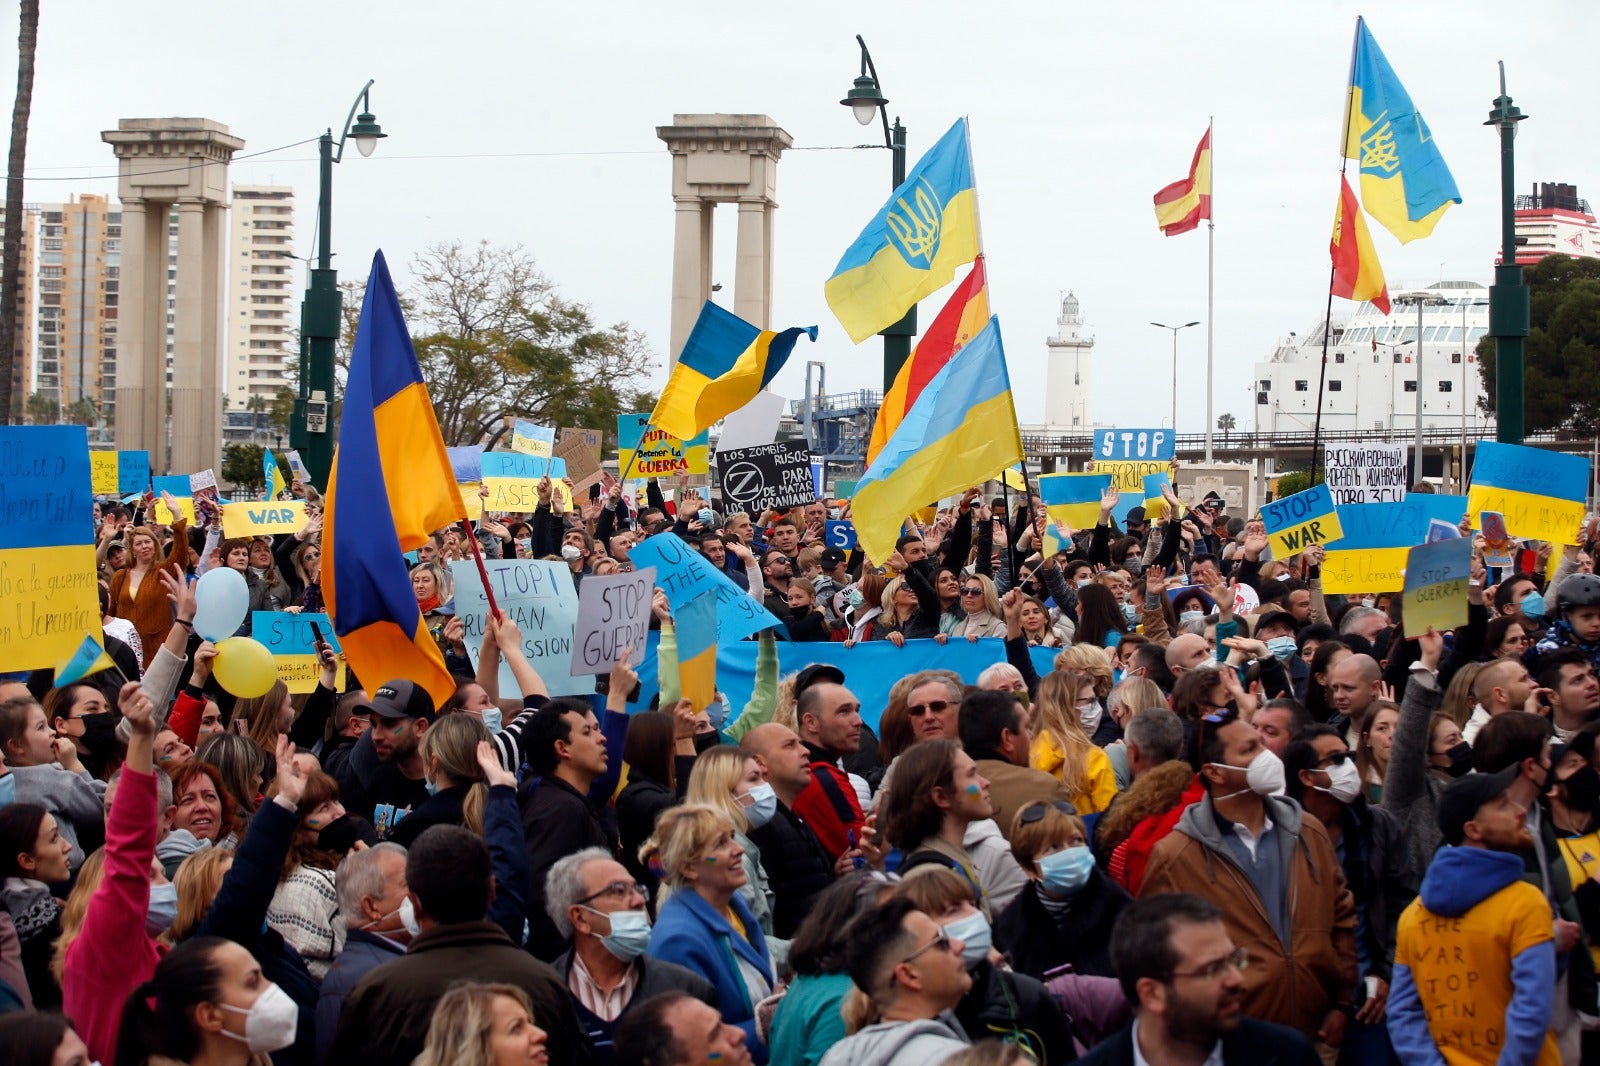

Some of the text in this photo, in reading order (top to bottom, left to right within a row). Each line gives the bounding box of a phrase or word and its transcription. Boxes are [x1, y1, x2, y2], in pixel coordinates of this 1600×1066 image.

[724, 450, 745, 462] LOS
[1101, 432, 1165, 458] STOP
[638, 457, 689, 473] GUERRA
[773, 450, 809, 466] RUSOS
[782, 467, 813, 486] PARA
[496, 484, 570, 508] ASESO
[763, 481, 814, 498] DE MATAR
[247, 508, 295, 525] WAR
[725, 503, 746, 515] LOS
[1269, 490, 1321, 529] STOP
[1280, 521, 1327, 551] WAR
[661, 561, 707, 595] THE
[1358, 555, 1406, 584] Ucrani
[1422, 566, 1451, 583] STOP
[601, 579, 645, 623] STOP
[1415, 580, 1460, 603] GUERRA
[270, 620, 333, 646] STOP
[464, 607, 545, 638] RUIAN
[583, 622, 645, 666] GUERRA
[1418, 918, 1462, 937] THE
[1426, 971, 1480, 995] TOP
